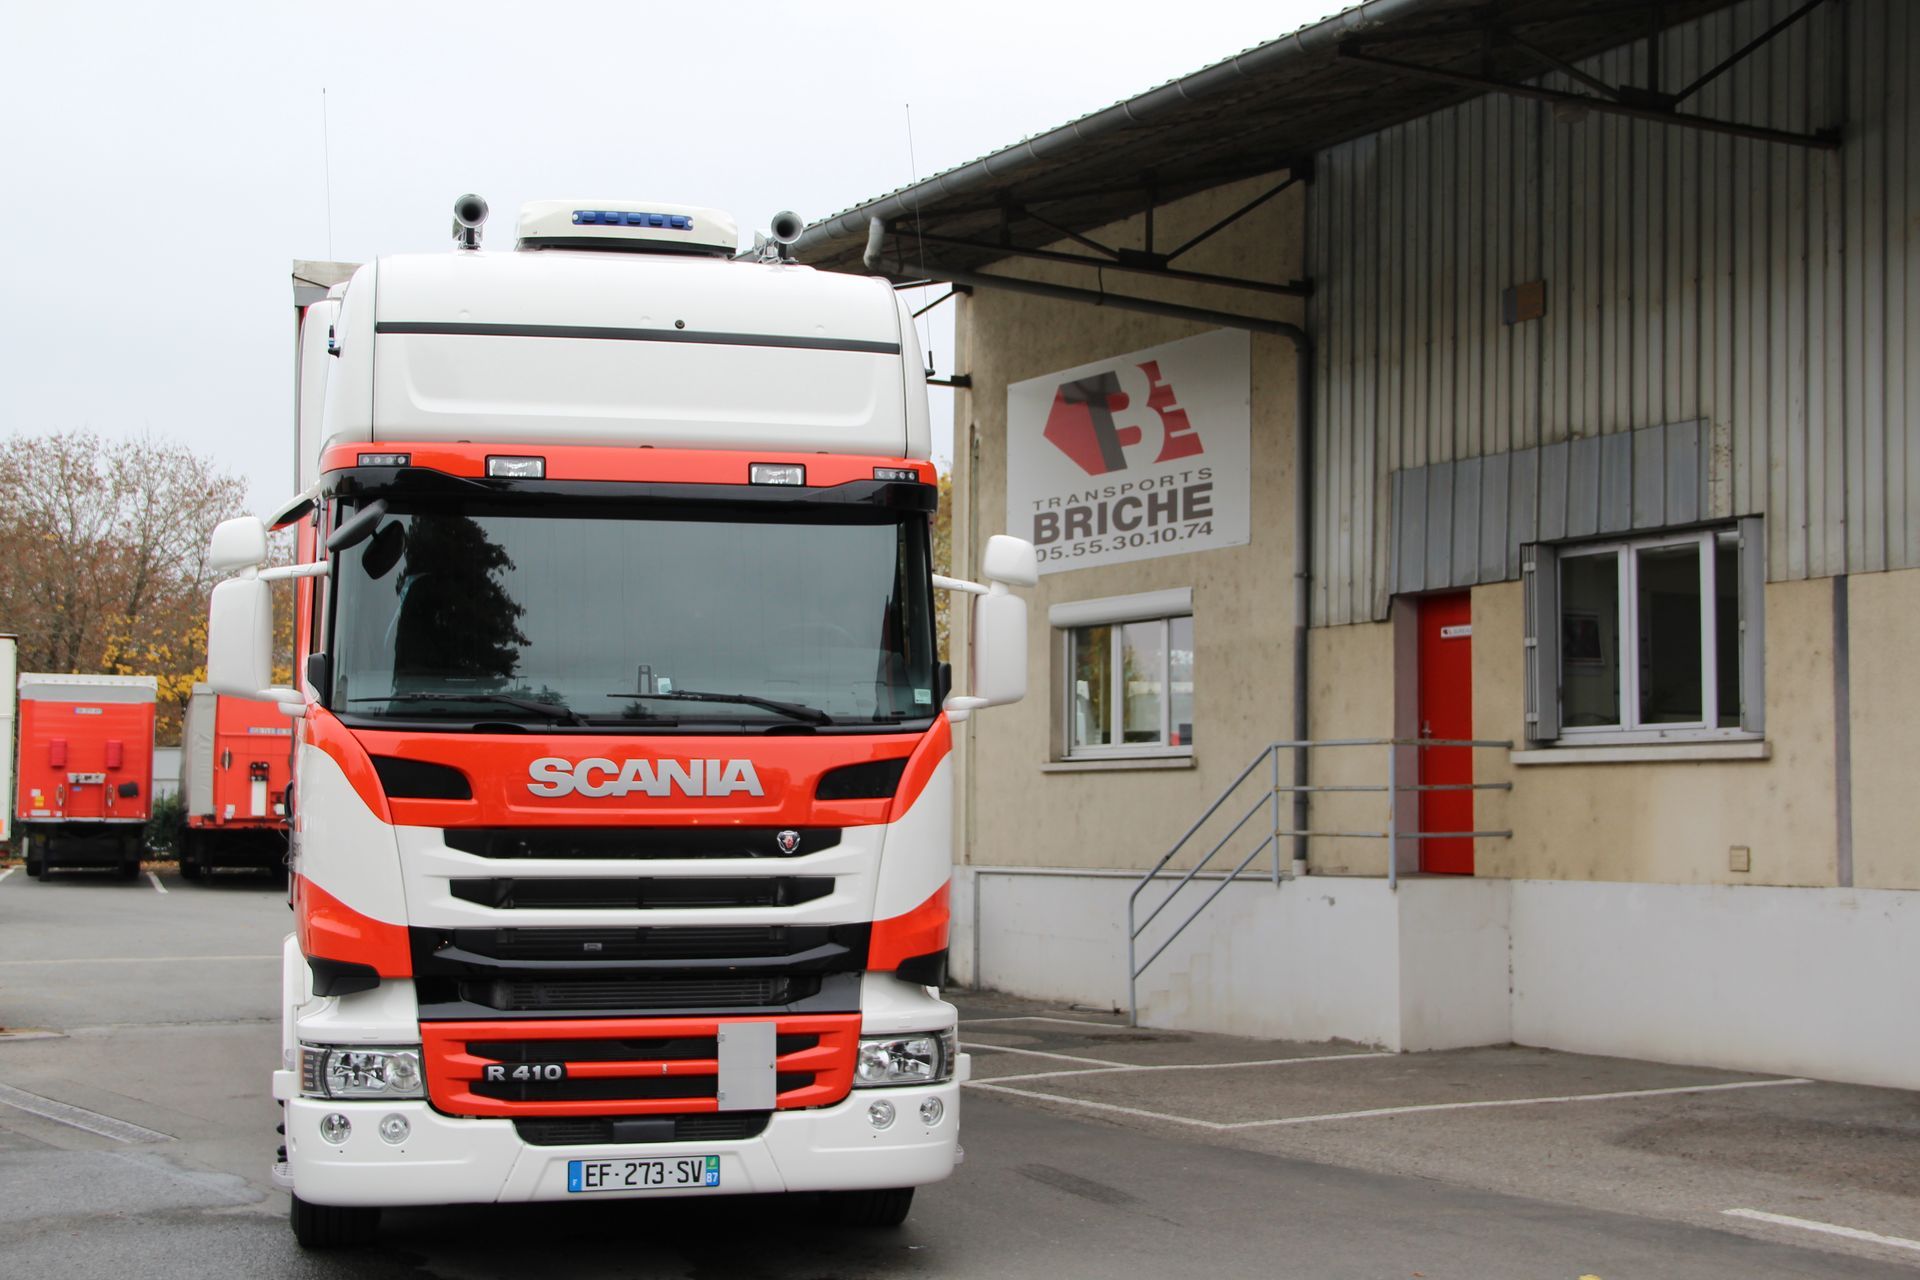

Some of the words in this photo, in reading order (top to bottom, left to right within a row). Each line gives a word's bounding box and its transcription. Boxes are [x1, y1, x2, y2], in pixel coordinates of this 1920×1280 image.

[1032, 467, 1213, 511] TRANSPORTS
[1033, 482, 1213, 546] BRICHE
[1036, 521, 1213, 562] 05.55.30.10.74
[527, 757, 765, 798] SCANIA
[487, 1065, 506, 1081] R
[512, 1064, 562, 1080] 410
[585, 1160, 703, 1187] EF-273-SV
[706, 1172, 718, 1183] 87
